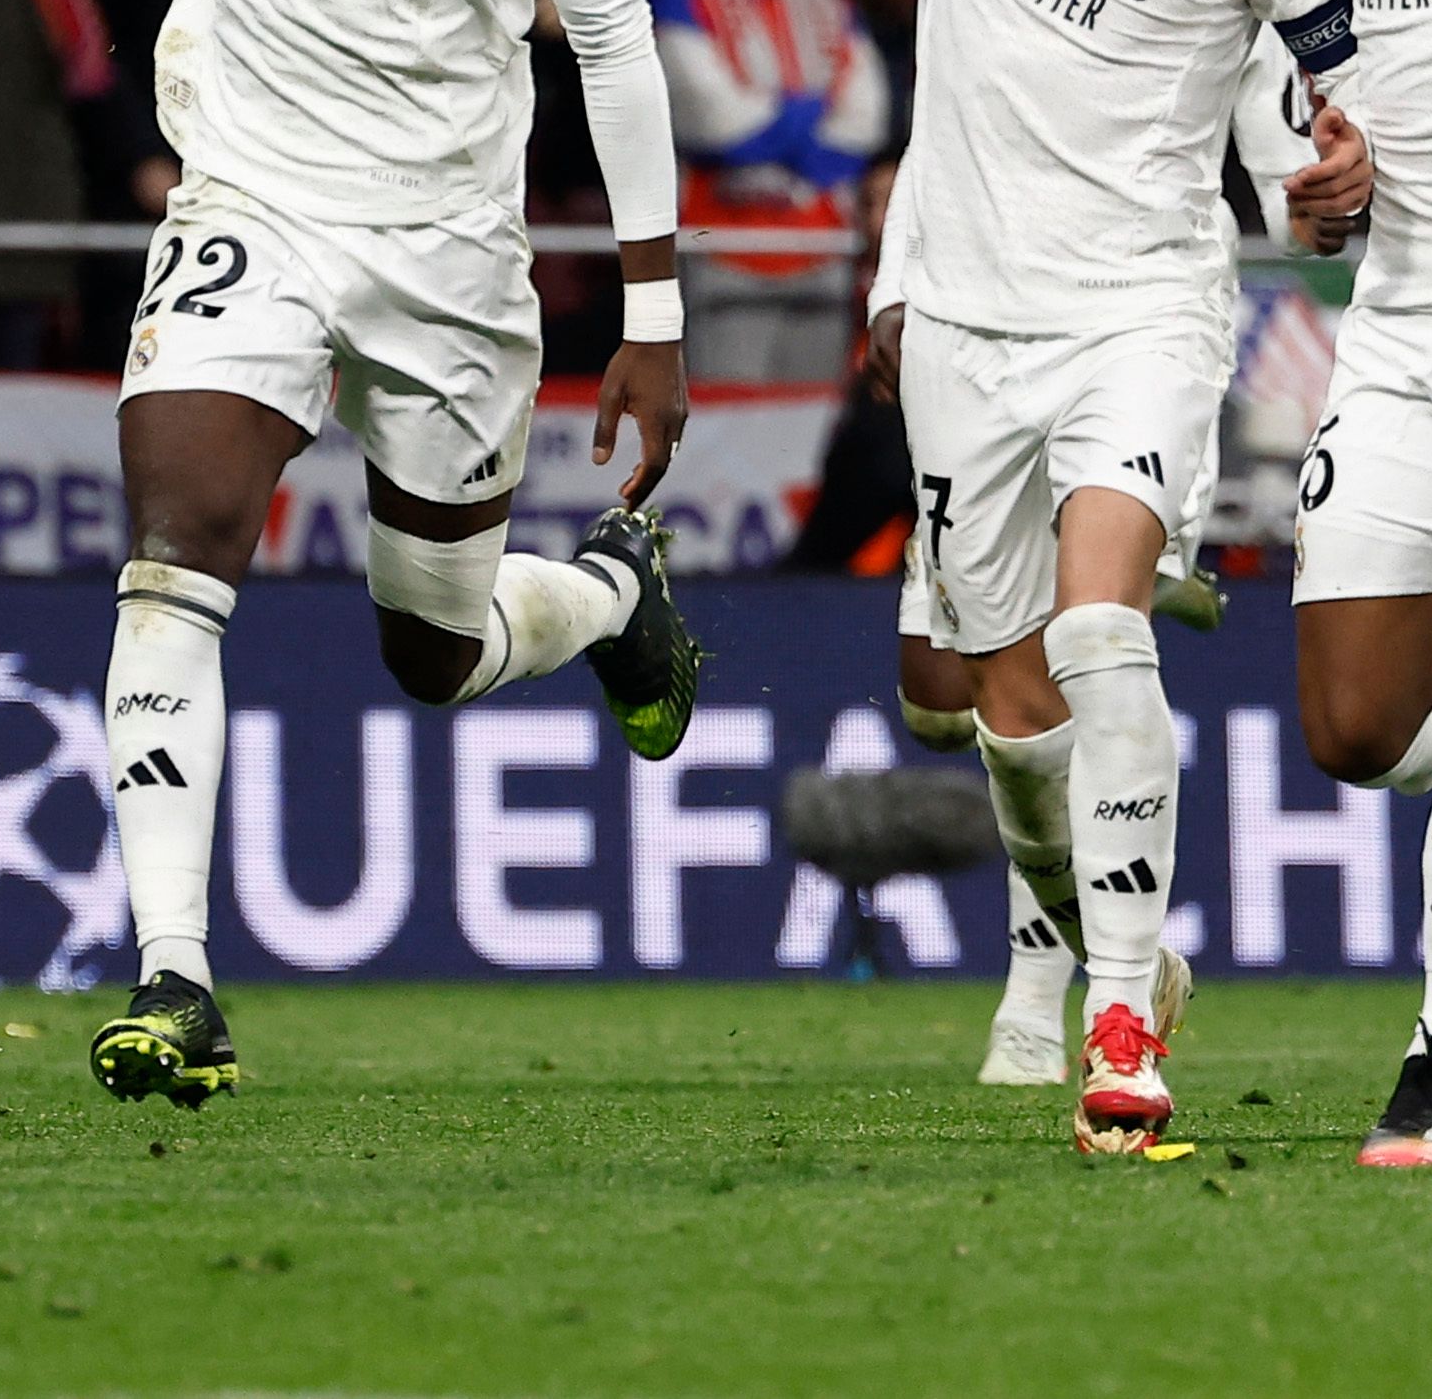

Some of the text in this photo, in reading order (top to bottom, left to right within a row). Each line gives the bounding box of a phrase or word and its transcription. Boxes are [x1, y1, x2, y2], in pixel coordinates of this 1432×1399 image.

[135, 236, 248, 323] 22
[113, 692, 191, 719] RMCF
[1093, 795, 1167, 821] RMCF
